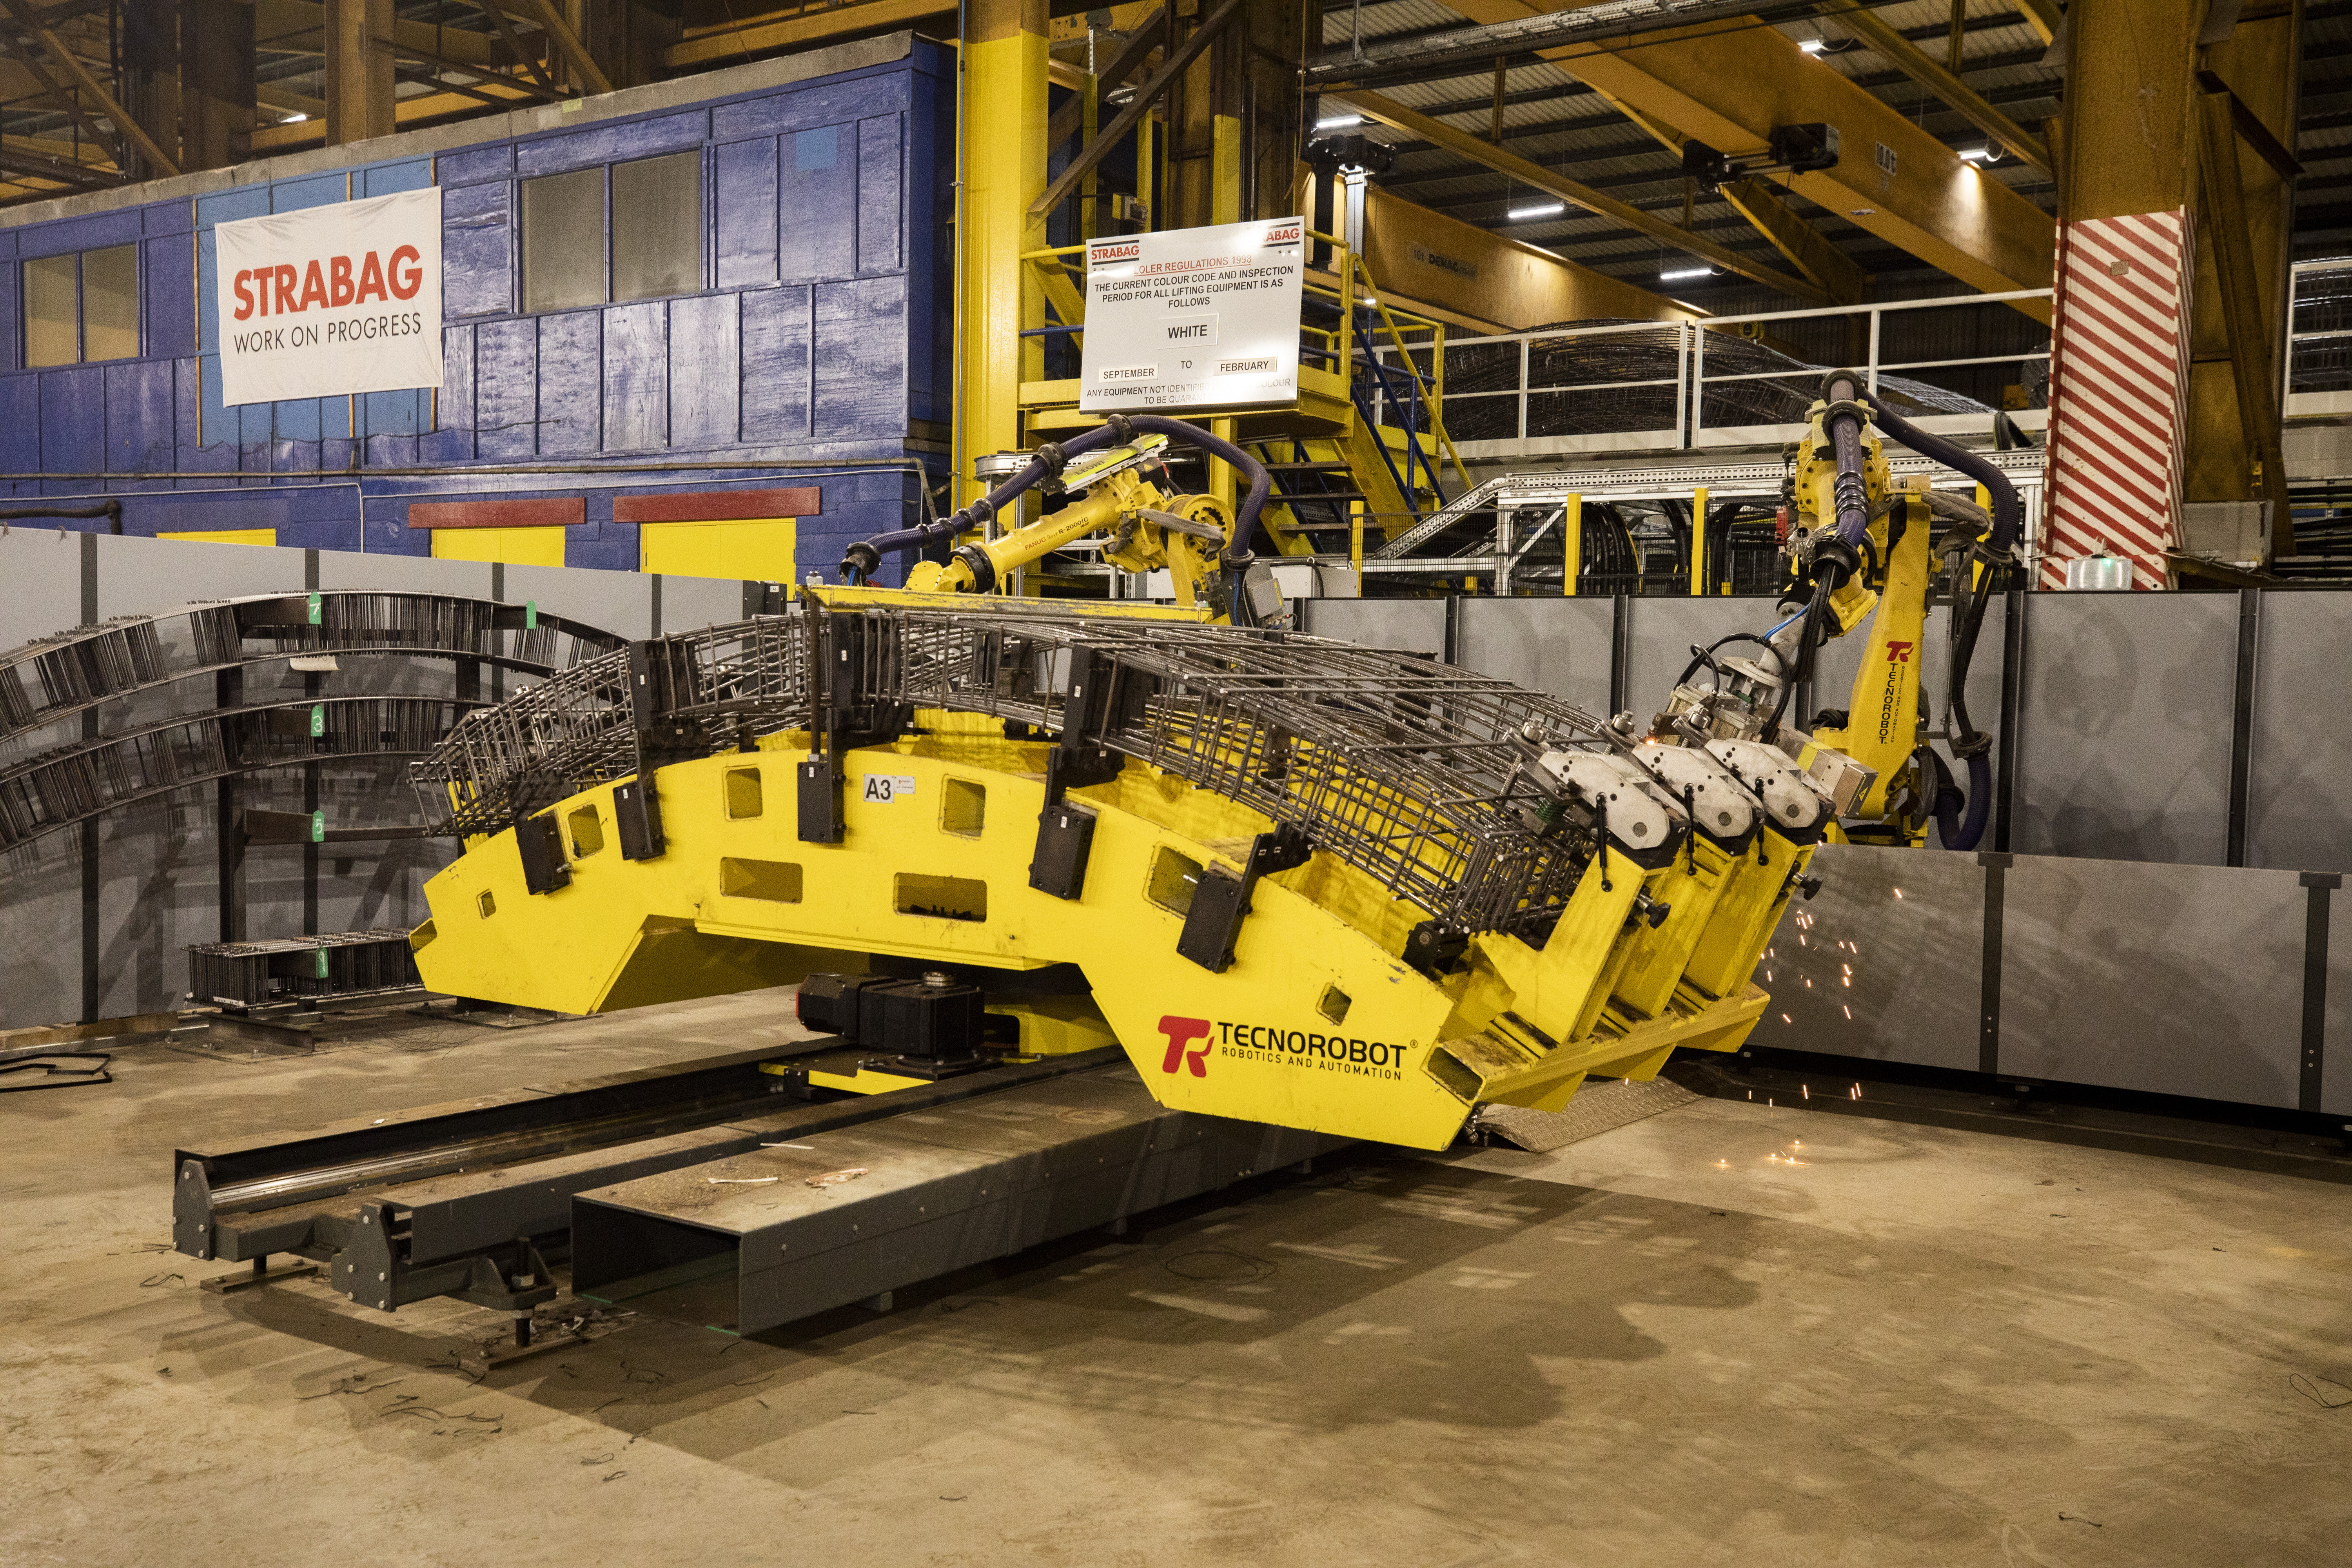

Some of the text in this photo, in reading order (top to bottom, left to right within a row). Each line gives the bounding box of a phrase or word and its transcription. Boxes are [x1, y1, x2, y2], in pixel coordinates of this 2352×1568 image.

[1263, 228, 1300, 242] ABAG
[1091, 245, 1139, 260] STRABAG
[1134, 254, 1251, 275] LOLER REGULATIONS 1998
[234, 245, 423, 321] STRABAG
[1095, 265, 1294, 292] THE CURRENT COLOUR CODE AND INSPECTION
[1102, 278, 1283, 303] PERIOD FOR ALL LIFTING EQUIPMENT IS AS
[1169, 296, 1210, 308] FOLLOWS
[234, 312, 421, 354] WORK ON PROGRESS
[1168, 325, 1208, 339] WHITE
[1103, 360, 1269, 379] SEPTEMBER TO FEBRUARY
[1104, 386, 1147, 396] EQUIPMENT
[1150, 385, 1165, 394] NOT
[1168, 382, 1210, 393] IDENTIFIED
[1025, 537, 1046, 550] FANUC
[1058, 517, 1089, 534] R-2000iC
[1879, 663, 1898, 744] TECNOROBOT
[313, 715, 323, 733] 3
[1890, 708, 1899, 743] AUTOMATION
[866, 778, 891, 800] A3
[316, 818, 323, 834] 5
[1218, 1021, 1407, 1069] TECNOROBOT
[1222, 1047, 1401, 1081] ROBOTICS AND AUTOMATION
